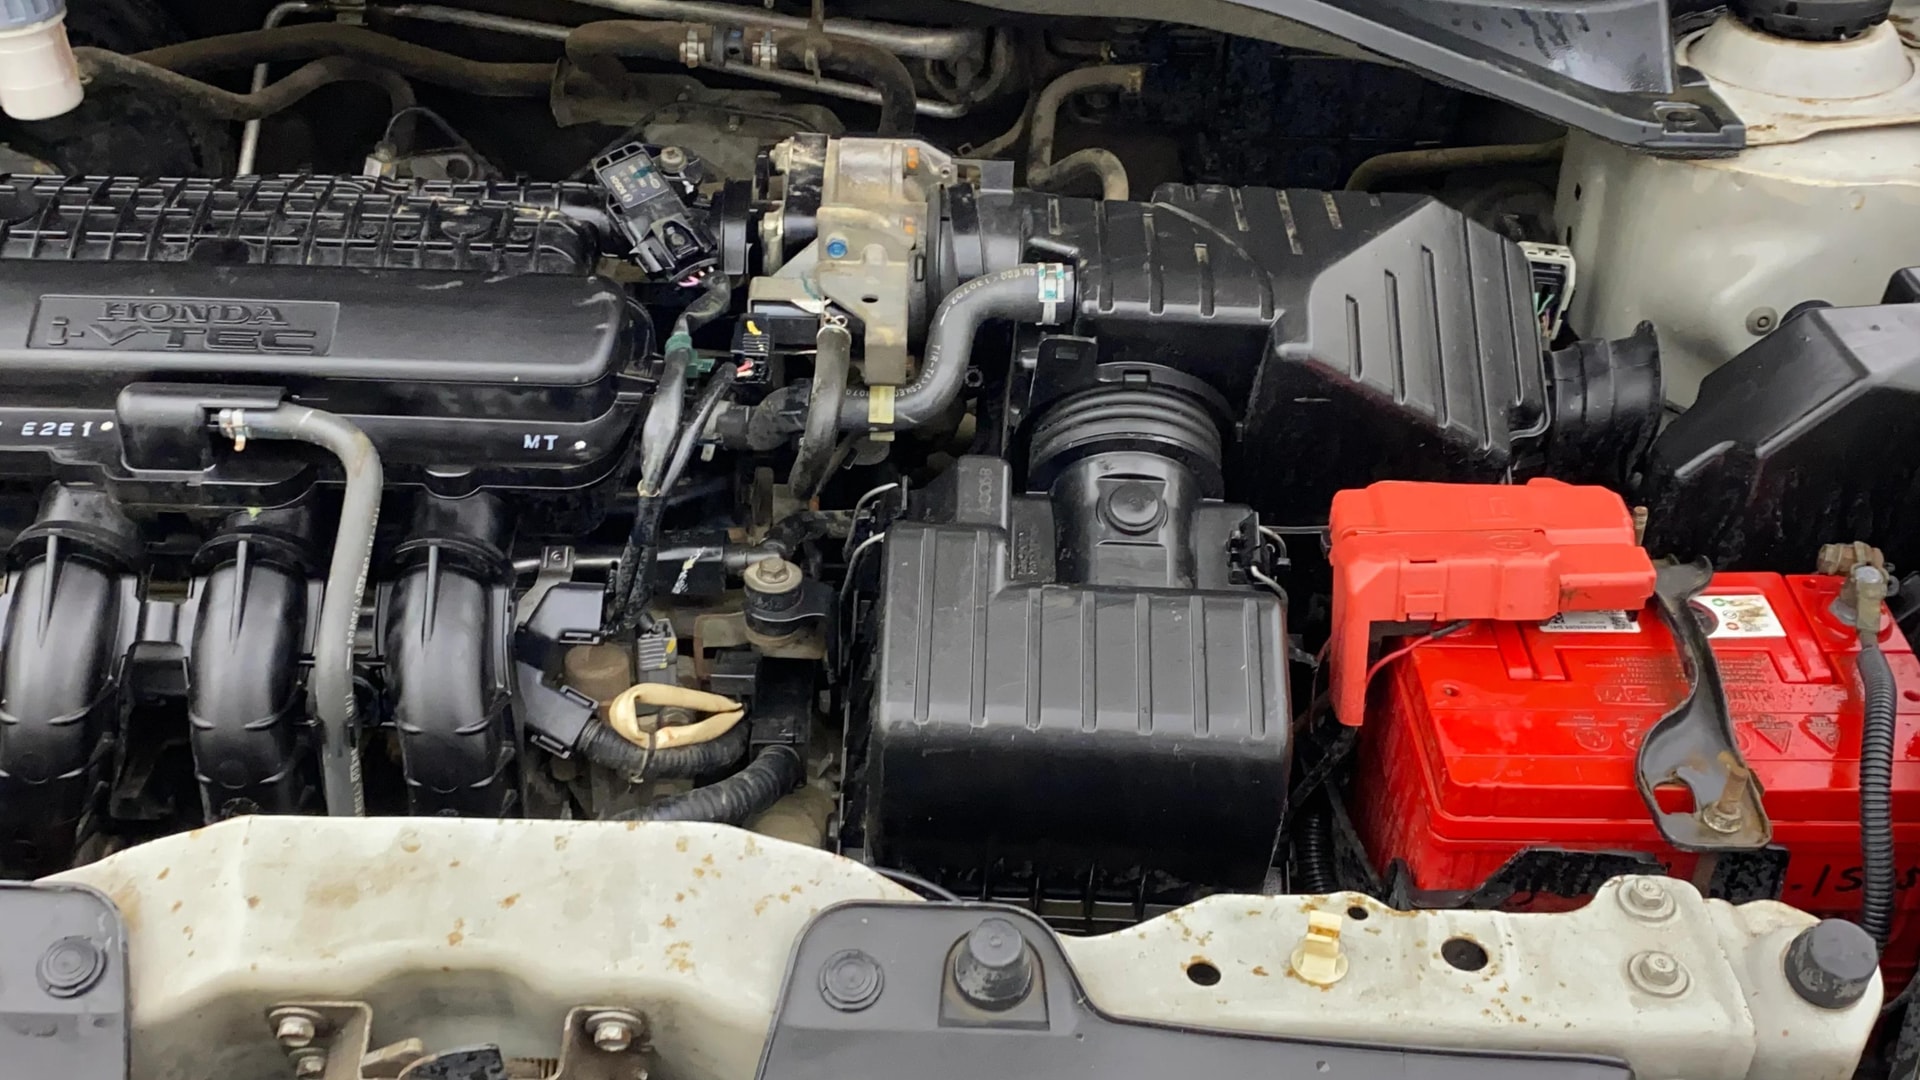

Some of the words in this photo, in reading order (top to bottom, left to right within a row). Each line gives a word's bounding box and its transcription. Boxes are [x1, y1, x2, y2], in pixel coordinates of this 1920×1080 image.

[97, 301, 289, 326] HONDA
[47, 317, 317, 352] i-VTEC
[523, 433, 559, 450] MT
